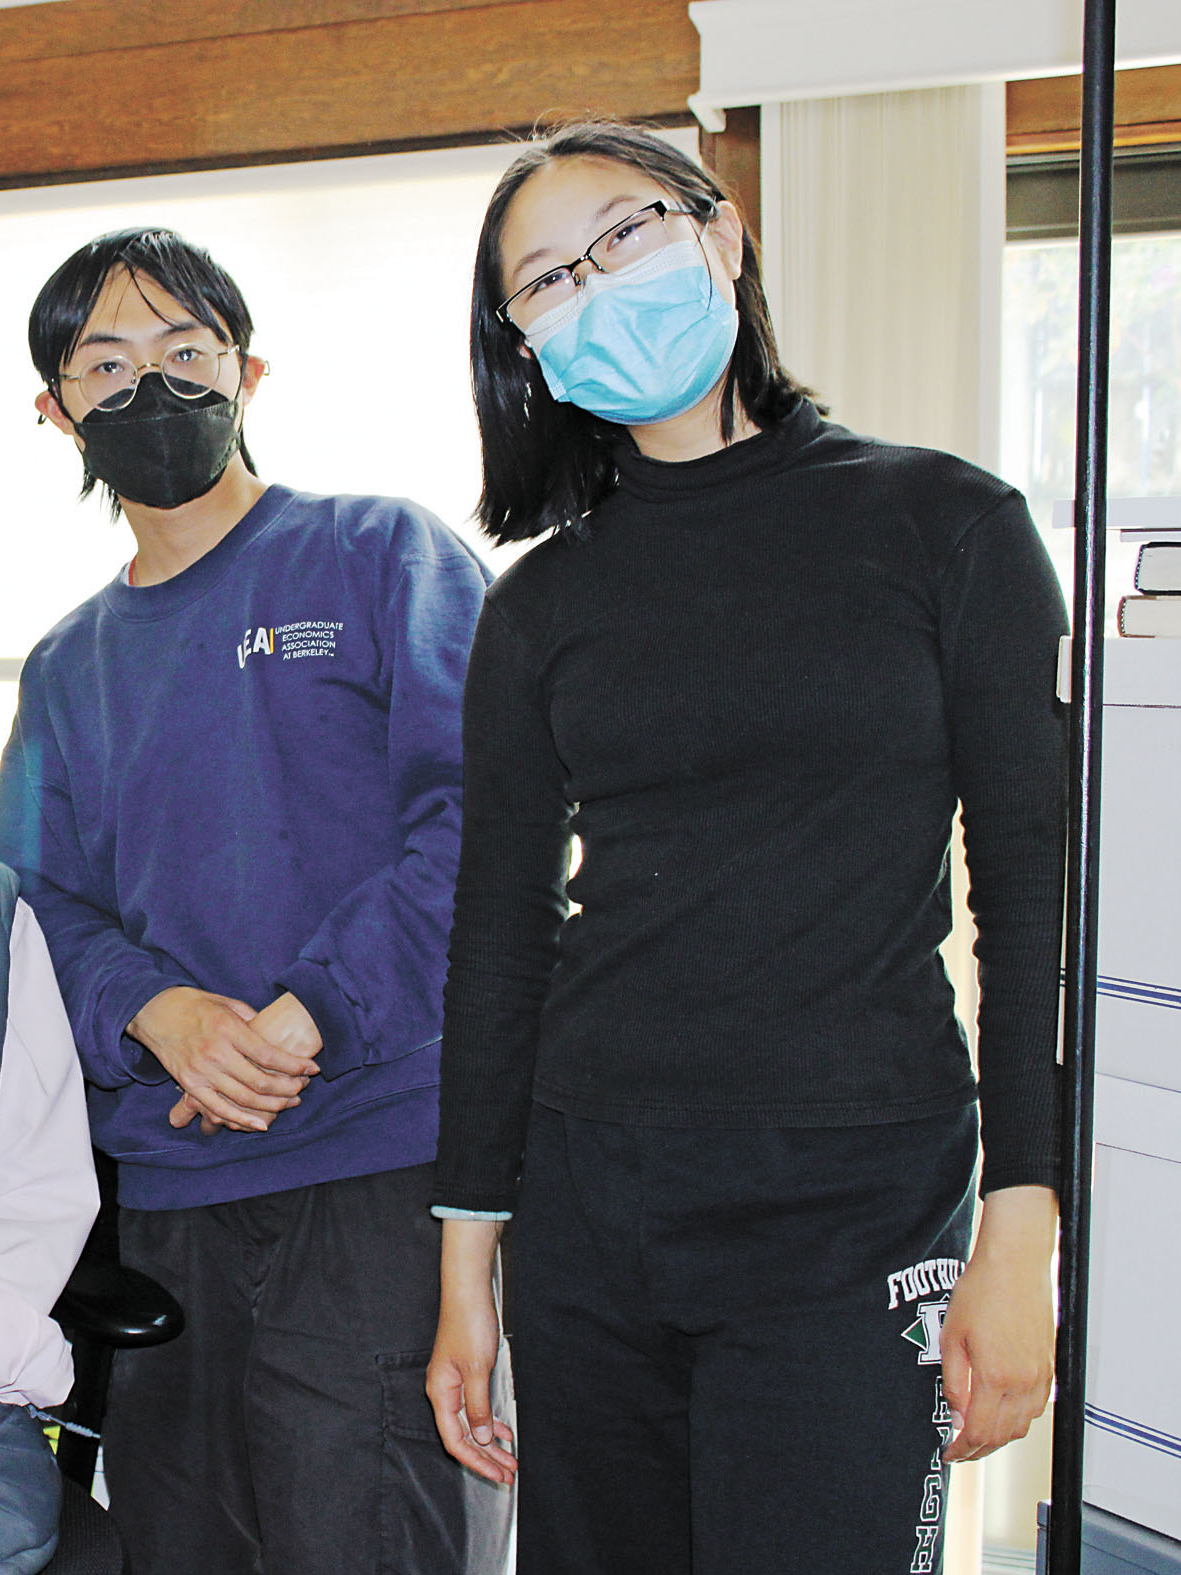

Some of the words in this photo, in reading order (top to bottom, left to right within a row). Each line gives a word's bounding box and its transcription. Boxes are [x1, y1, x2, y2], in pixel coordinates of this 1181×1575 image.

[275, 621, 344, 635] UNDERGRADUATE
[282, 631, 334, 642] ECONOMICS
[281, 640, 336, 652] ASSOCIATION
[283, 652, 291, 660] AT
